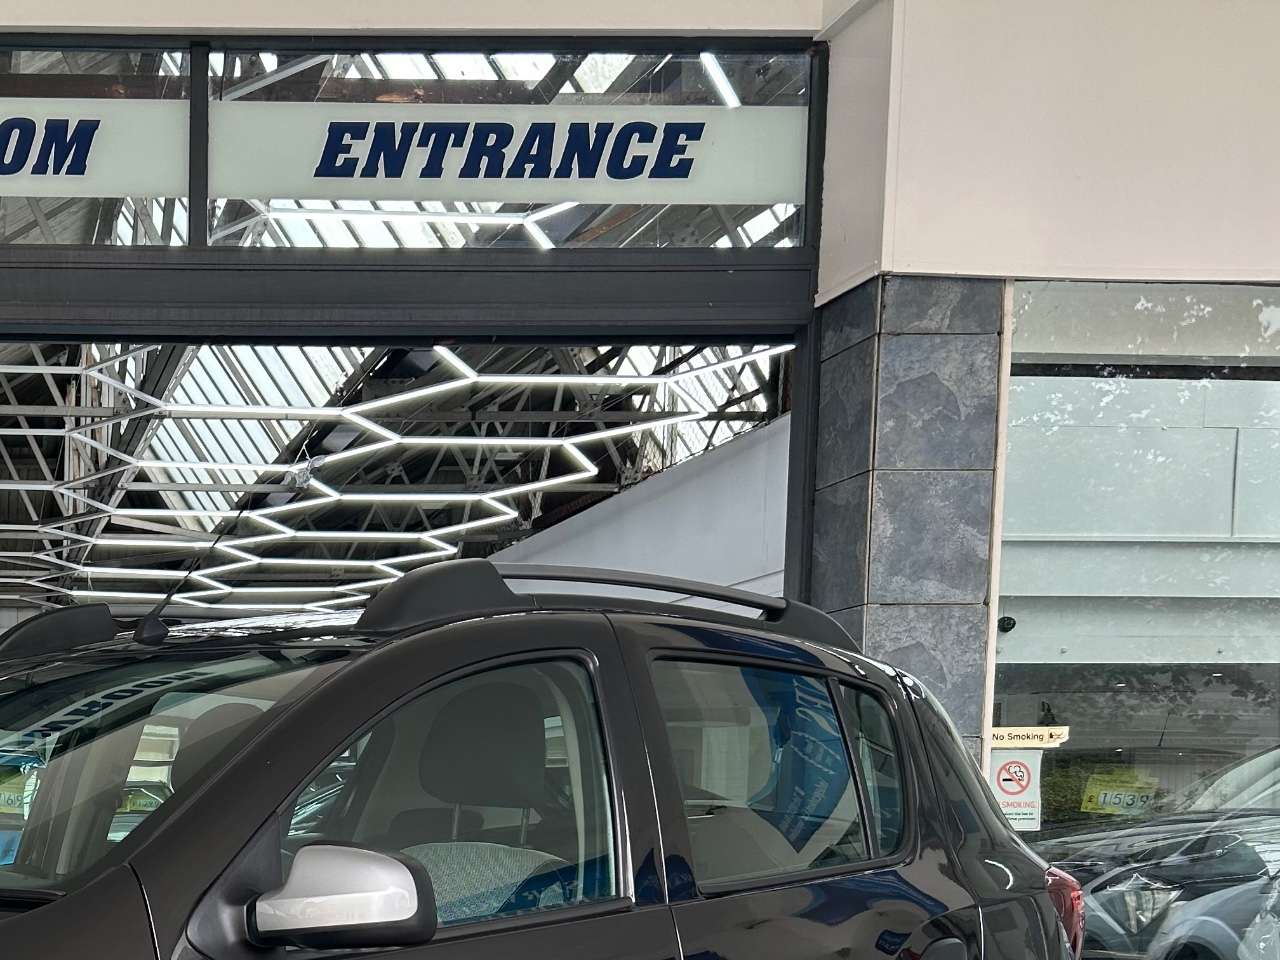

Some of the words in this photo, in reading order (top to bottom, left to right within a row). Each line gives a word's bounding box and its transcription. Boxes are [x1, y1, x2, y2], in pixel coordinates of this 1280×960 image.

[314, 121, 704, 178] ENTRANCE
[992, 732, 1005, 741] No
[1007, 732, 1045, 742] Smoking
